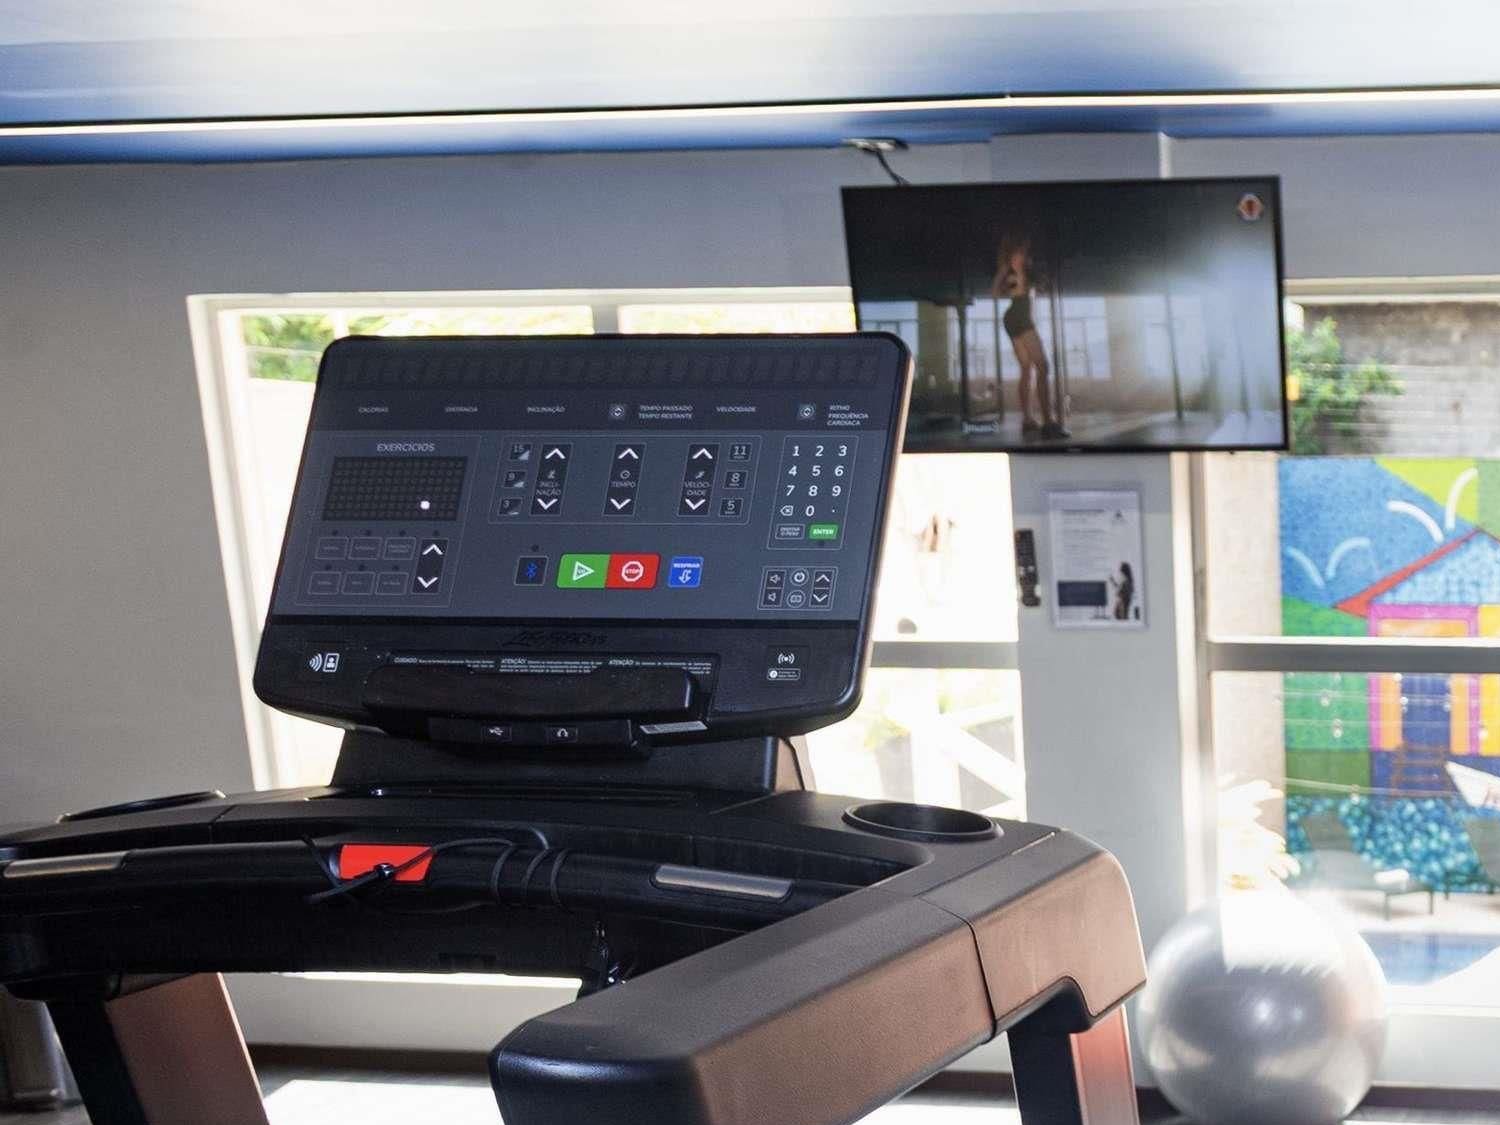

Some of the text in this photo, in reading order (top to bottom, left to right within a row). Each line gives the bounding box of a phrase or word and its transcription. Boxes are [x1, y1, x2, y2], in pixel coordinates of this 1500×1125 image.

[638, 412, 660, 420] TEMPO
[733, 446, 746, 455] 11
[792, 445, 847, 457] 1 2 3
[788, 465, 844, 477] 4 5 6
[731, 472, 741, 482] 8
[786, 485, 841, 497] 7 8 9
[805, 505, 815, 516] 0
[624, 567, 641, 575] STOP
